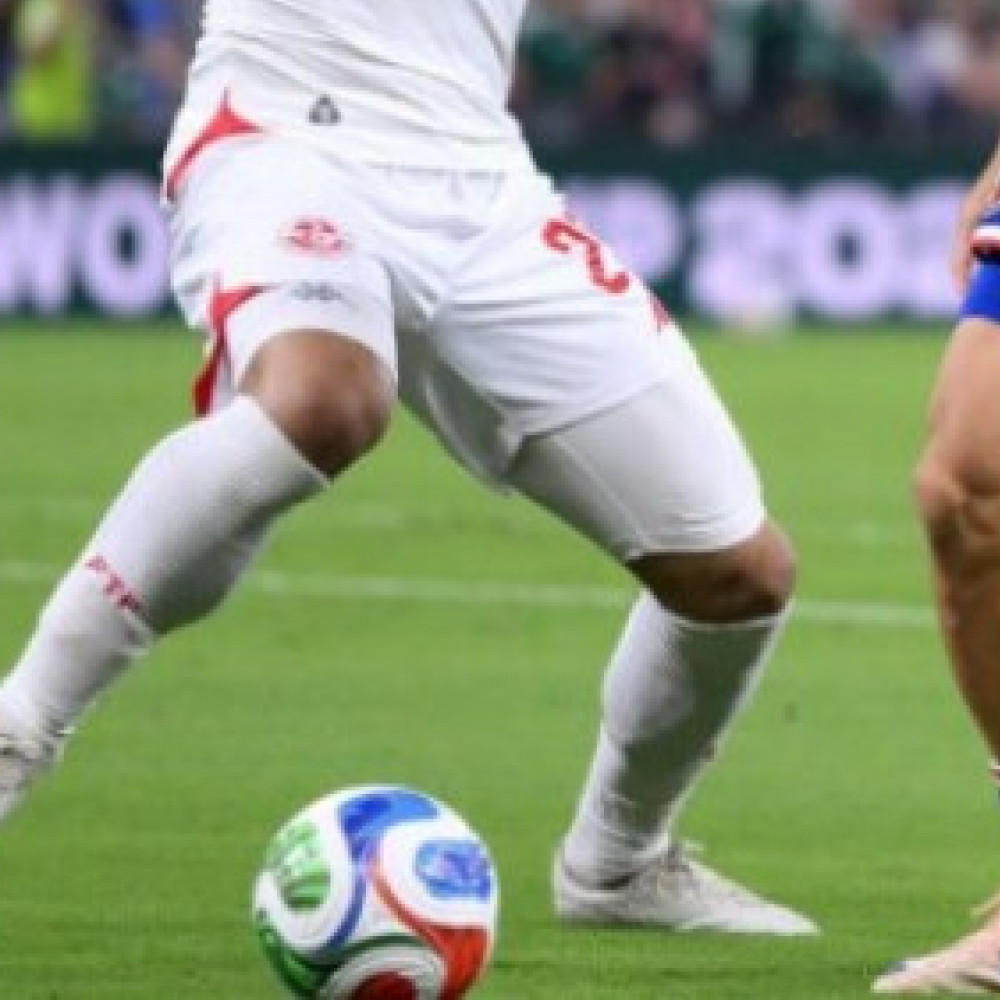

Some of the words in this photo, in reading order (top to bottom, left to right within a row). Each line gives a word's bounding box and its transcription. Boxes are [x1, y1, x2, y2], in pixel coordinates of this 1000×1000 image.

[0, 173, 172, 316] WO
[688, 174, 966, 316] 202
[541, 220, 630, 294] 2
